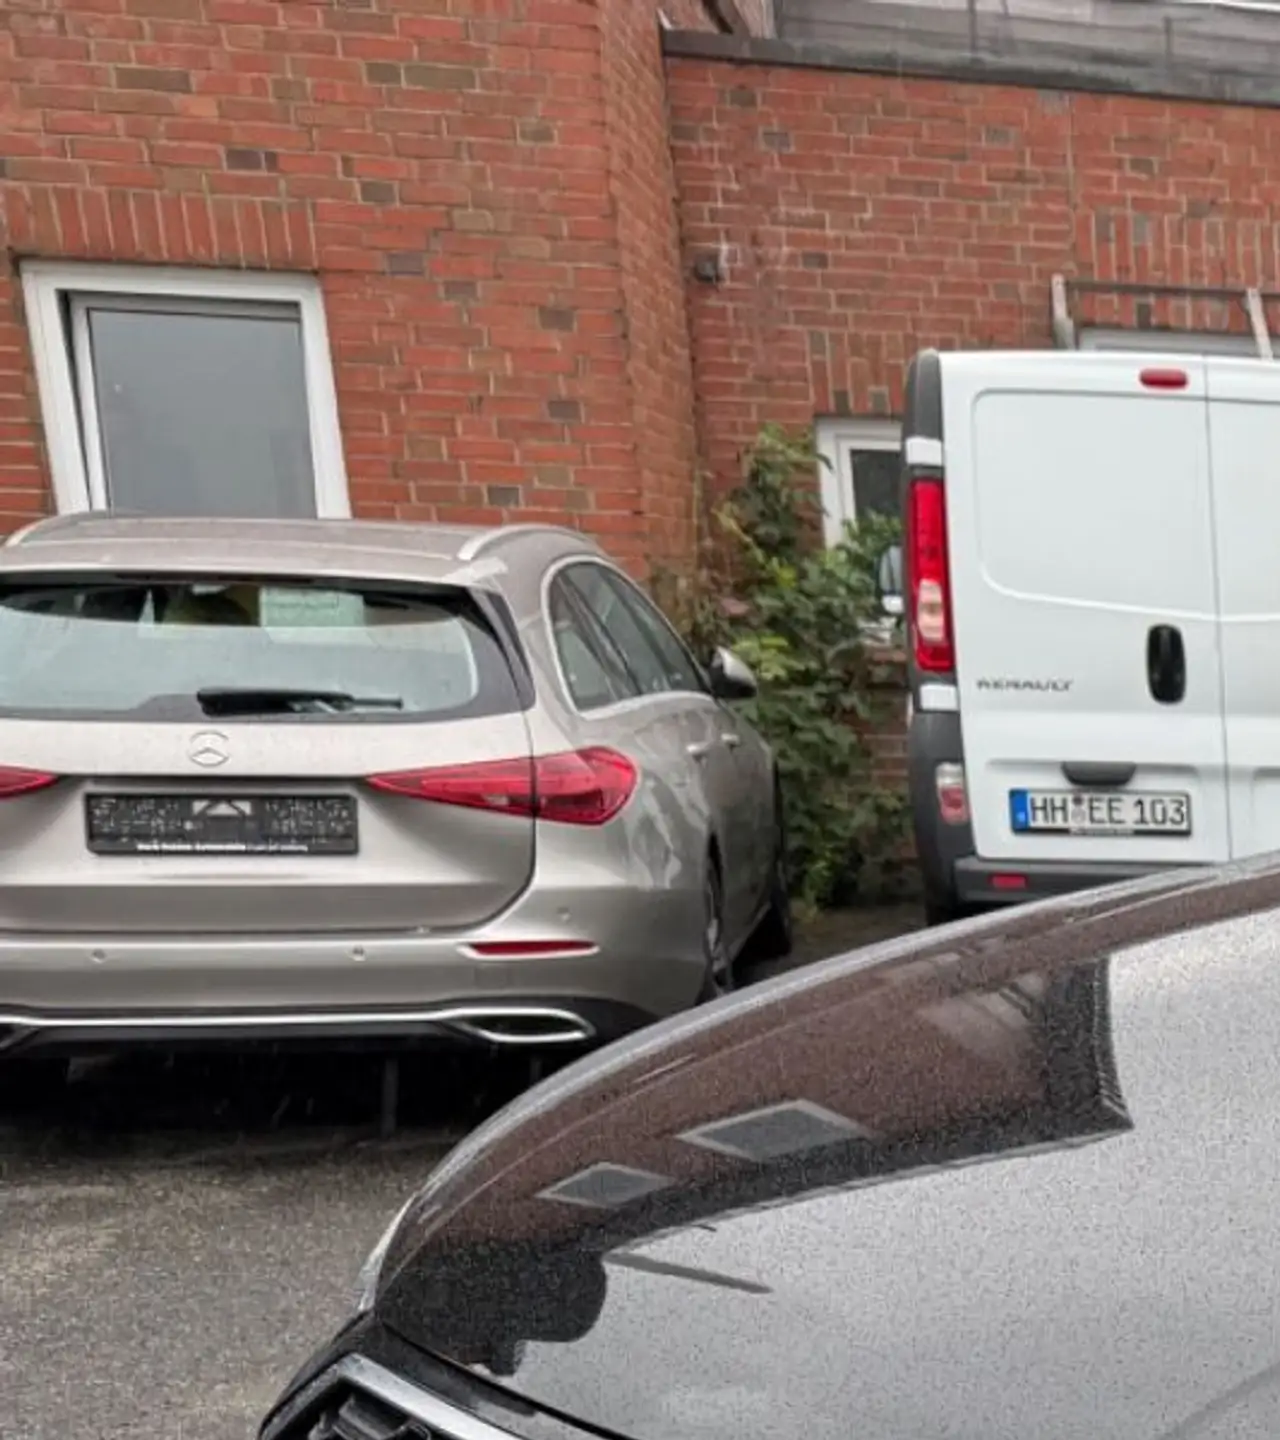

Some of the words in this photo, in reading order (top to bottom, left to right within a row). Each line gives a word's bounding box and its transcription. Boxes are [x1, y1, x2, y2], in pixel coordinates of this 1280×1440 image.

[976, 679, 1073, 692] RENAULT
[1030, 797, 1069, 824] HH
[1089, 797, 1126, 825] EE
[1134, 798, 1185, 826] 103
